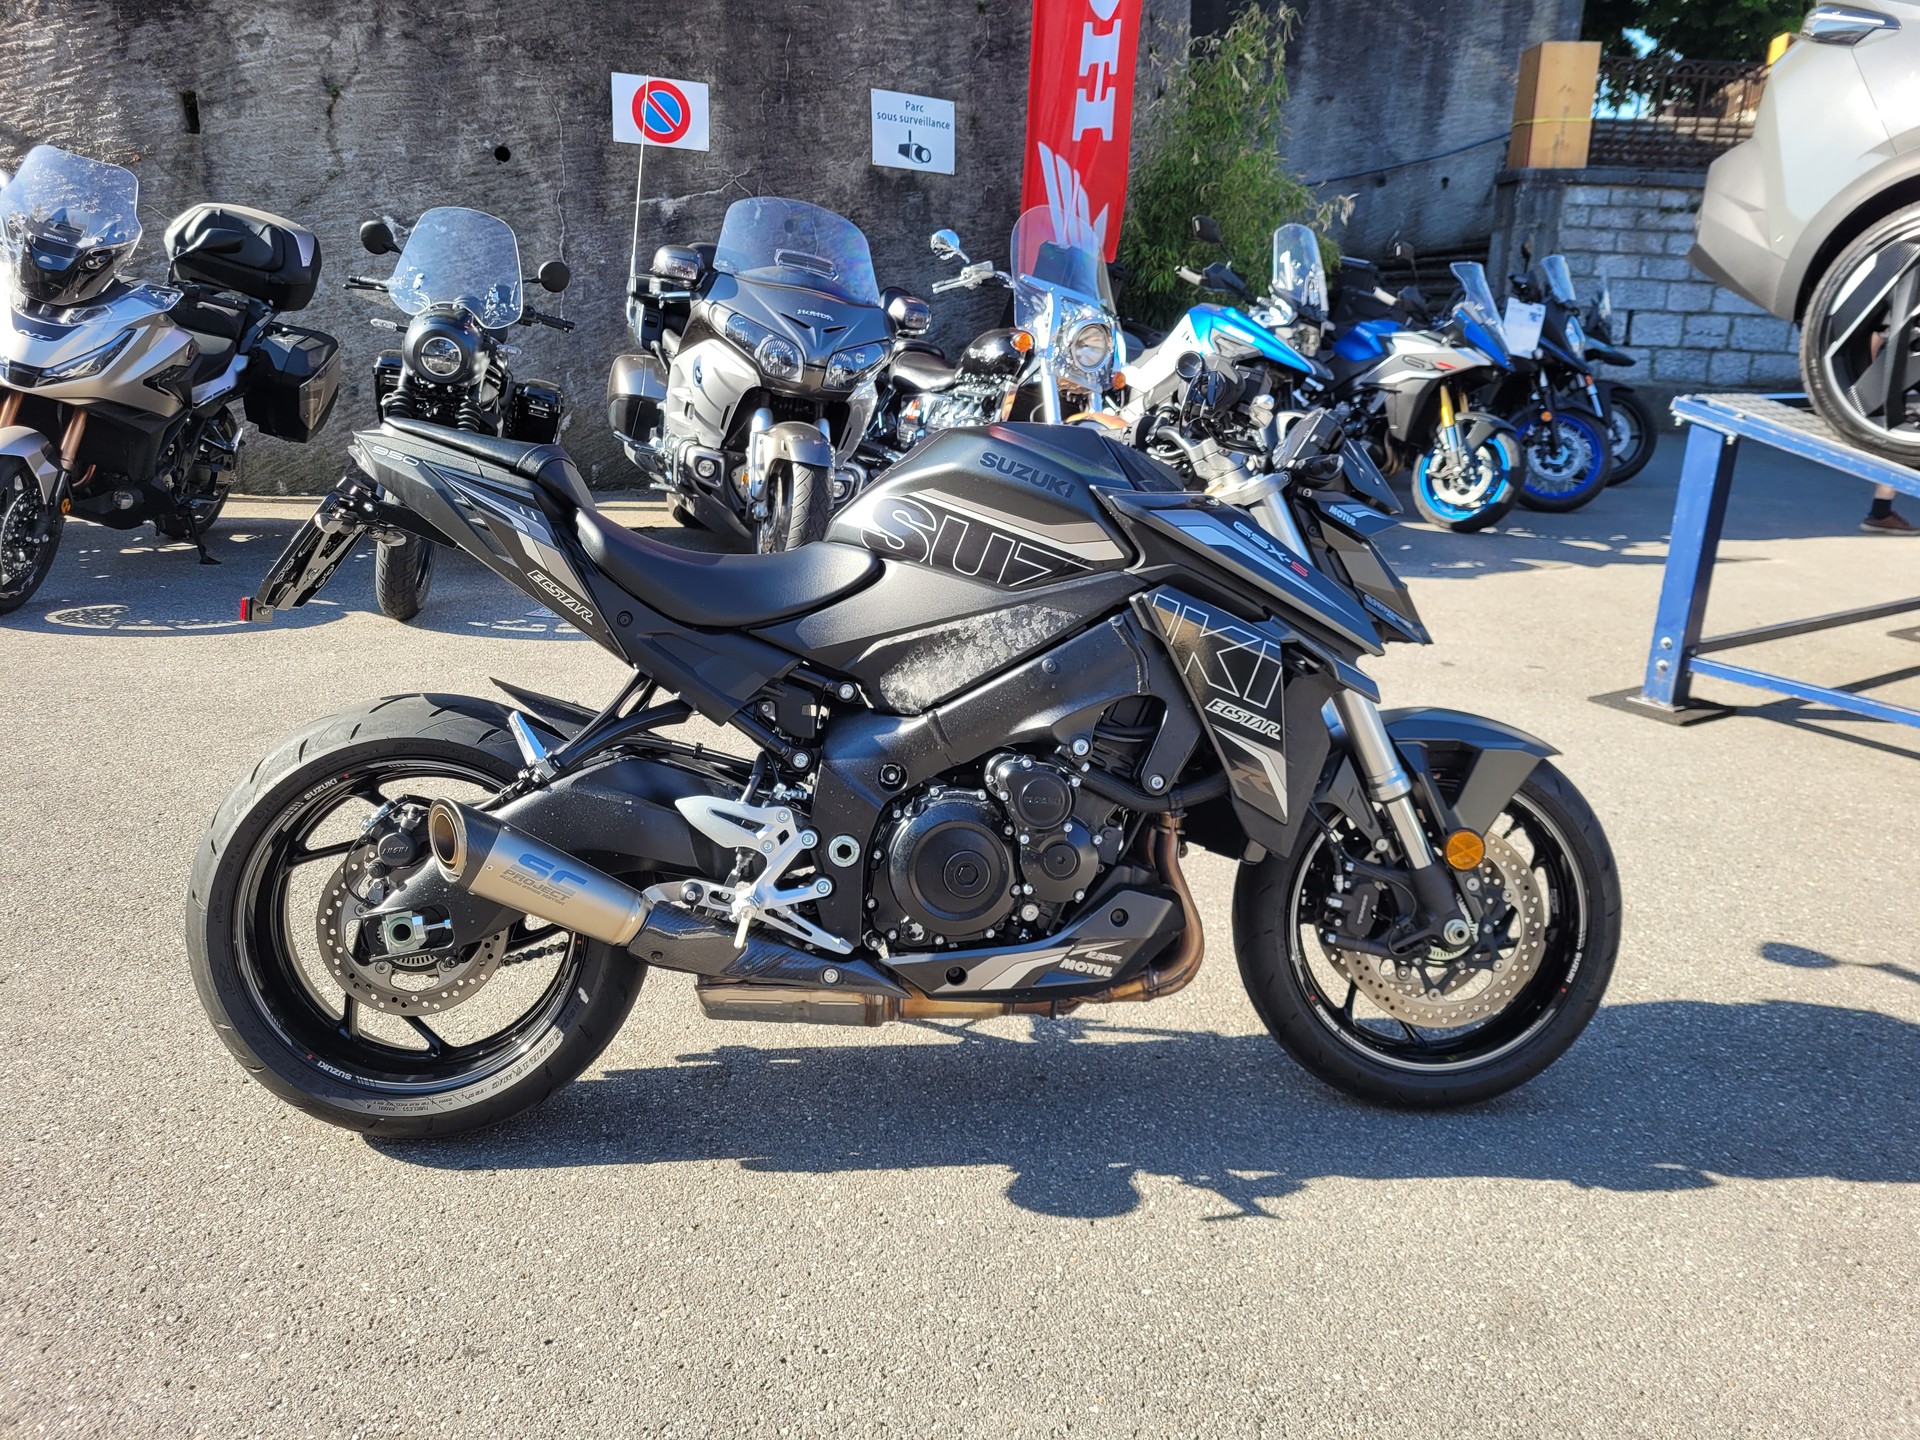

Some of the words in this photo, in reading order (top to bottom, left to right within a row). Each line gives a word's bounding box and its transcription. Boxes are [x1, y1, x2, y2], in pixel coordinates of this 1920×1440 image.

[905, 100, 924, 113] Parc
[877, 112, 897, 121] sous
[900, 115, 950, 130] surveillance
[43, 232, 68, 243] HONDA
[797, 308, 835, 322] HONDA
[372, 446, 420, 467] 950
[979, 451, 1077, 499] SUZUKI
[1328, 504, 1357, 527] MOTUL
[1233, 520, 1308, 577] GSX-S
[527, 569, 594, 626] ECSTAR
[1205, 698, 1282, 741] ECSTAR
[303, 777, 339, 801] SUZUKI
[502, 868, 571, 902] PROJECT
[509, 853, 589, 898] SC
[1059, 958, 1113, 977] MOTUL
[317, 1060, 353, 1081] SUZUKI
